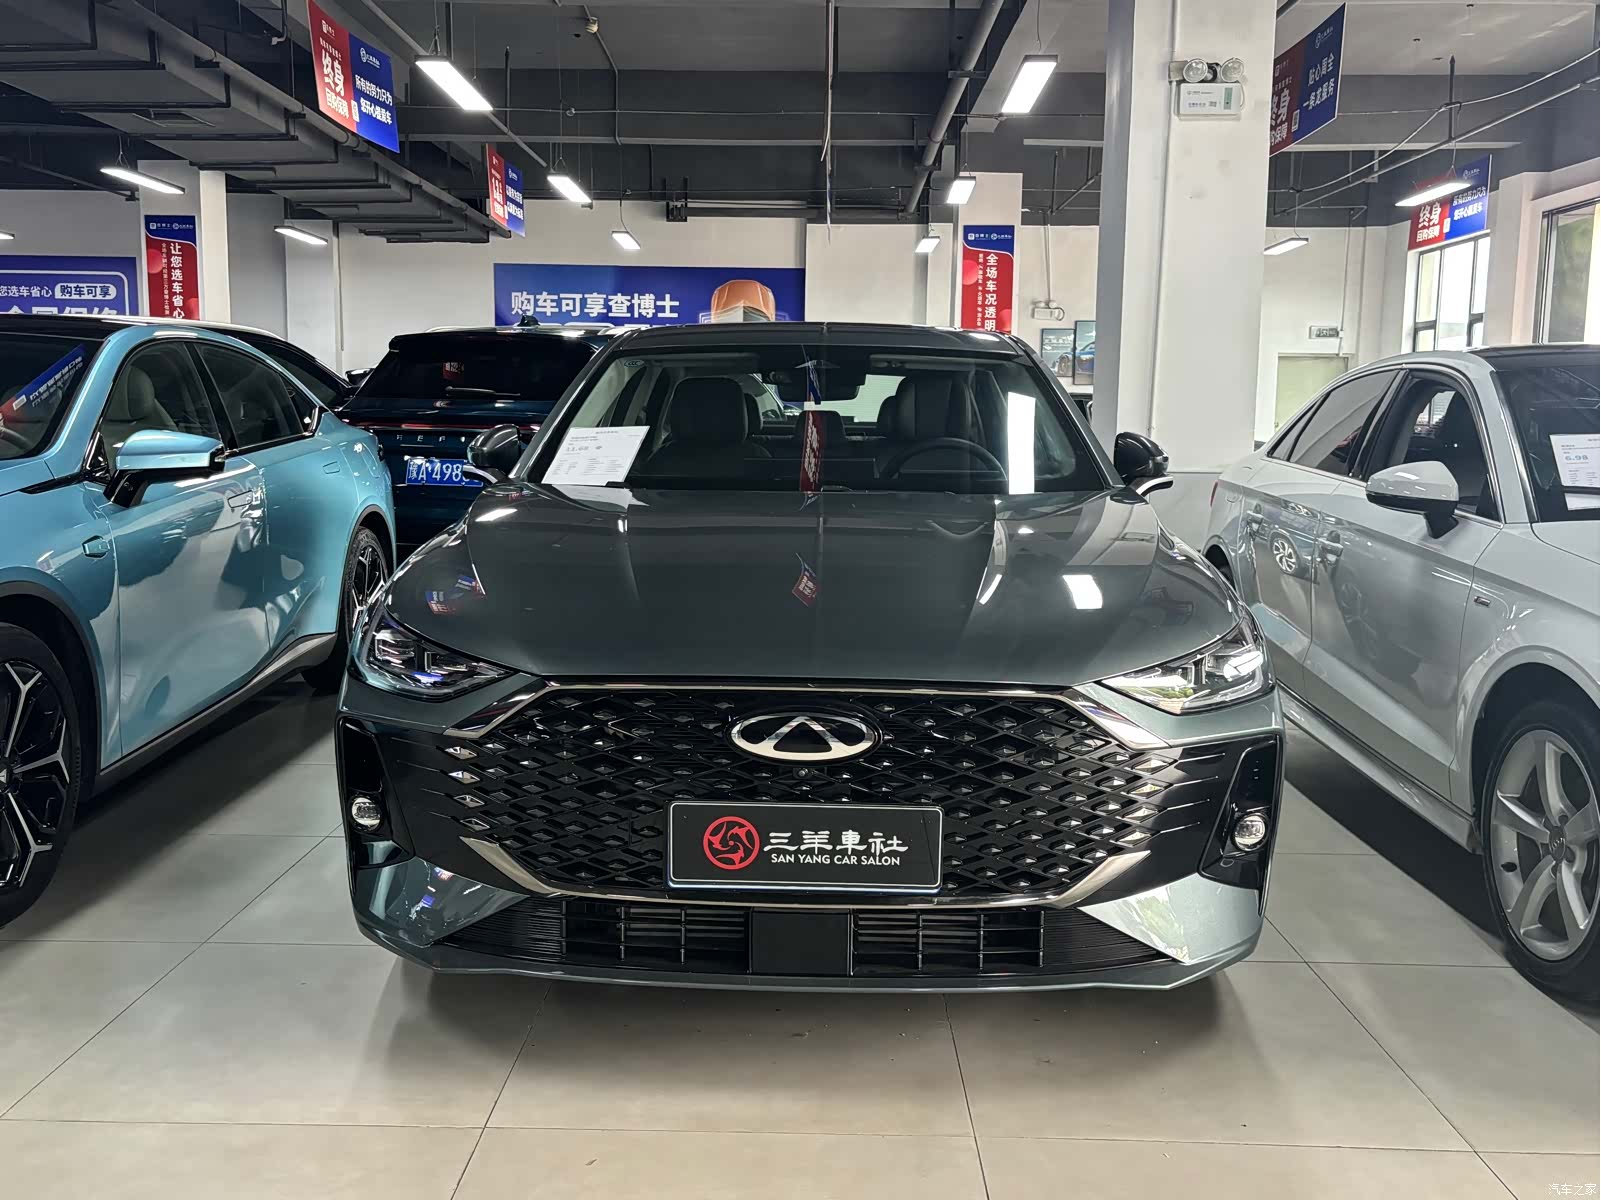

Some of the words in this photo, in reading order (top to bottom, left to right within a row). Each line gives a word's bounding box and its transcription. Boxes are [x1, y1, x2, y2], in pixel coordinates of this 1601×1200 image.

[321, 48, 345, 97] 终身
[1418, 202, 1441, 228] 终身
[60, 284, 112, 298] 购车可享
[169, 243, 185, 319] 让您选车省心
[984, 253, 998, 331] 全场车况透明
[511, 291, 680, 318] 购车可享查博士
[771, 853, 795, 863] SAN
[798, 854, 831, 865] YANG
[834, 854, 858, 865] CAR
[860, 855, 900, 866] SALON
